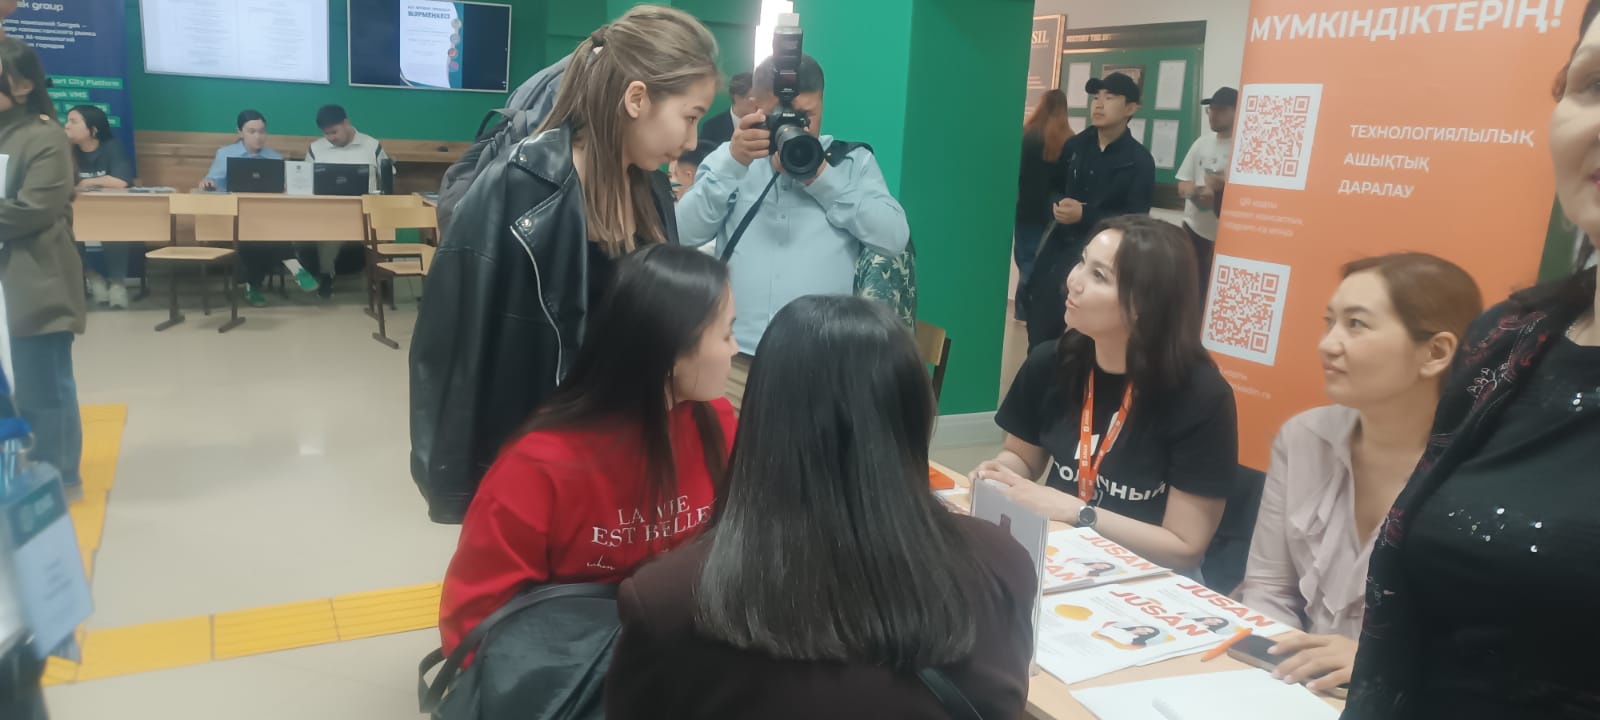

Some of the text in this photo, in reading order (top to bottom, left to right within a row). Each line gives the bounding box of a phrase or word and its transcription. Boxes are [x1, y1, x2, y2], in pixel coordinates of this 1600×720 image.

[32, 2, 64, 12] group
[1250, 0, 1565, 41] МҮМКІНДІКТЕРІҢ!
[68, 79, 84, 87] City
[1350, 124, 1534, 147] ТЕХНОЛОГИЯЛЫЛЫҚ
[1343, 152, 1429, 172] АШЫҚТЫҚ
[1337, 179, 1414, 198] ДАРАЛАУ
[618, 495, 690, 525] LA VIE
[592, 505, 713, 547] EST BELLE
[1080, 534, 1158, 571] JUSAN
[1109, 591, 1210, 637] JUSAN
[1176, 583, 1275, 628] JUSAN
